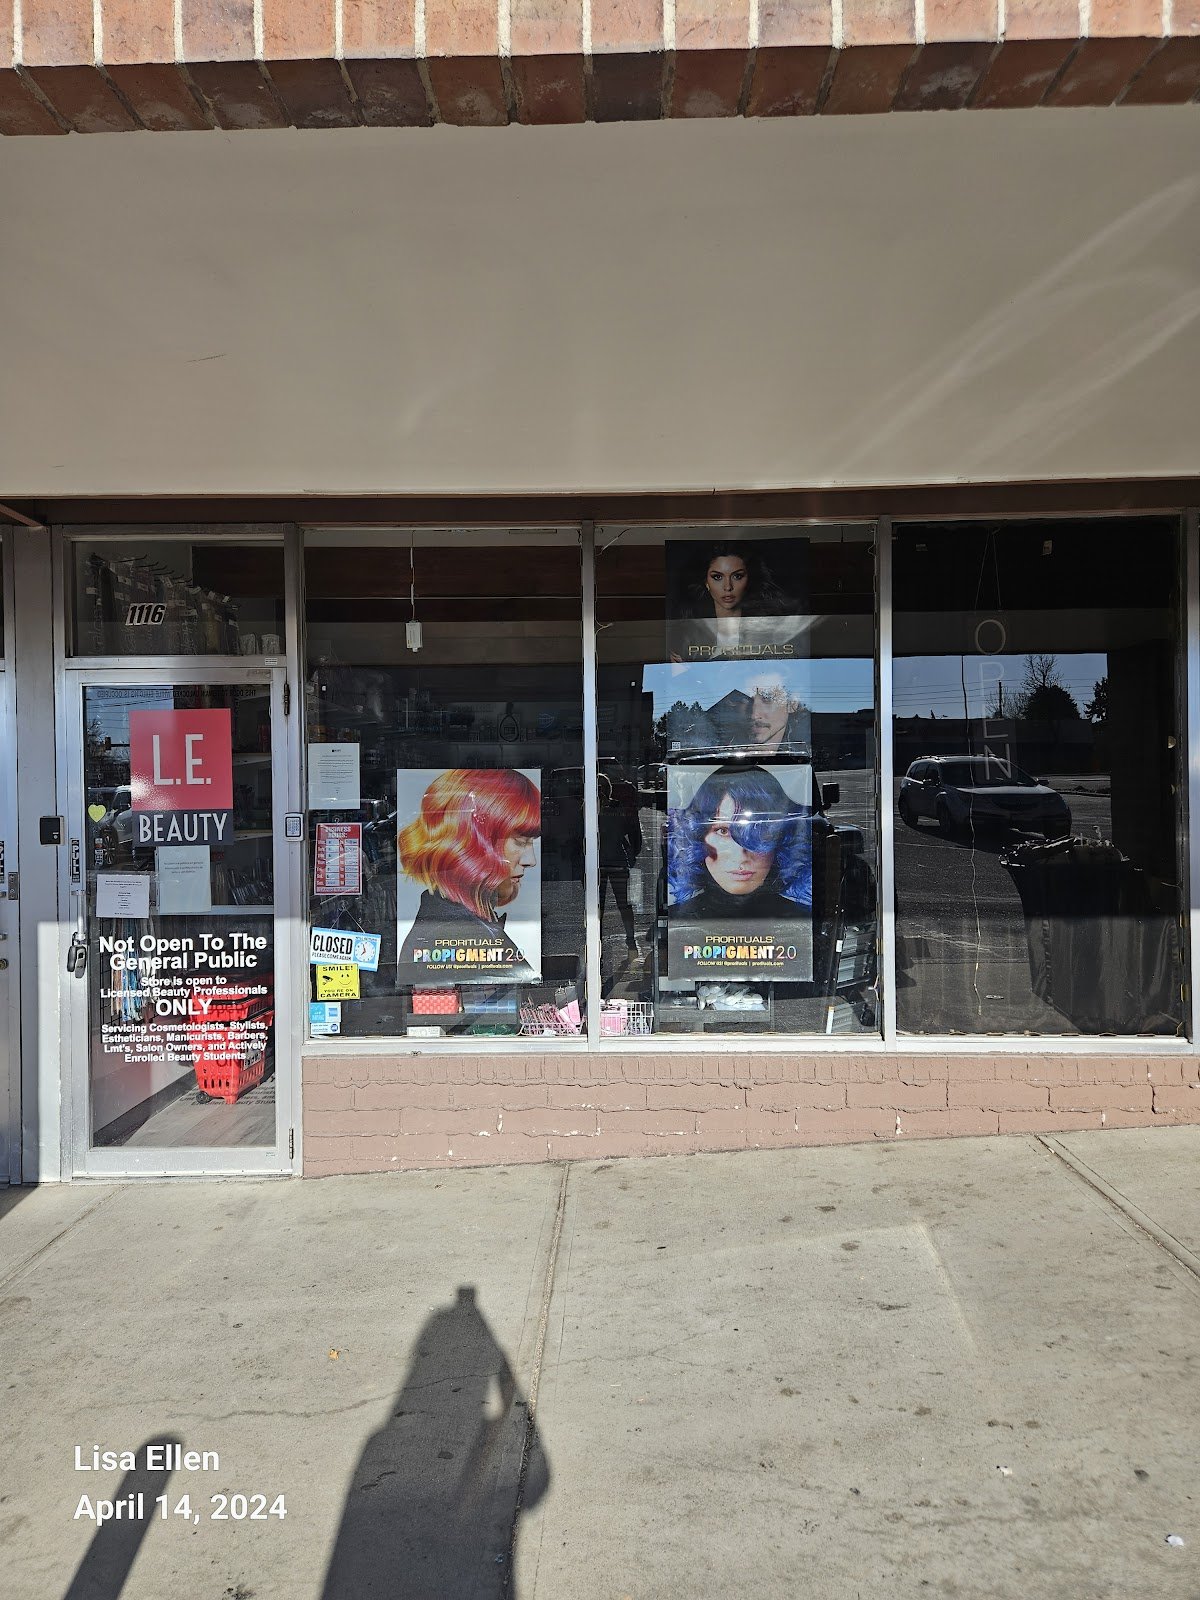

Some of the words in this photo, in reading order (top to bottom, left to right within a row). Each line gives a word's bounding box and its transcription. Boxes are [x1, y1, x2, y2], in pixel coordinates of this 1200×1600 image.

[129, 604, 166, 624] 1116
[688, 644, 794, 656] PRORITUALS
[975, 618, 1012, 781] OPEN
[152, 734, 212, 785] L.E.
[139, 813, 228, 842] BEAUTY
[100, 936, 134, 953] Not
[140, 934, 194, 955] Open
[199, 934, 224, 950] To
[228, 933, 267, 950] The
[312, 934, 352, 955] CLOSED
[413, 948, 504, 963] PROPIGMENT
[505, 948, 526, 962] 2.0
[684, 945, 775, 959] PROPIGMENT
[776, 945, 797, 959] 2.0
[110, 952, 188, 971] General
[194, 952, 257, 968] Public
[140, 976, 171, 987] Store
[173, 976, 182, 986] is
[186, 977, 212, 987] open
[215, 976, 227, 985] to
[100, 988, 150, 998] Licensed
[153, 987, 190, 998] Beauty
[193, 985, 267, 996] Professionals
[156, 998, 212, 1016] ONLY
[102, 1023, 147, 1034] Servicing
[149, 1022, 228, 1033] Cosmetologists,
[230, 1021, 268, 1032] Stylists,
[102, 1033, 164, 1043] Estheticians,
[166, 1032, 224, 1042] Manicurists,
[228, 1031, 268, 1041] Barbers,
[104, 1044, 133, 1054] Lmt's,
[136, 1043, 164, 1052] Salon
[166, 1042, 205, 1052] Owners,
[208, 1042, 226, 1050] and
[228, 1040, 267, 1051] Actively
[124, 1054, 165, 1063] Enrolled
[168, 1052, 201, 1062] Beauty
[204, 1052, 246, 1061] Students
